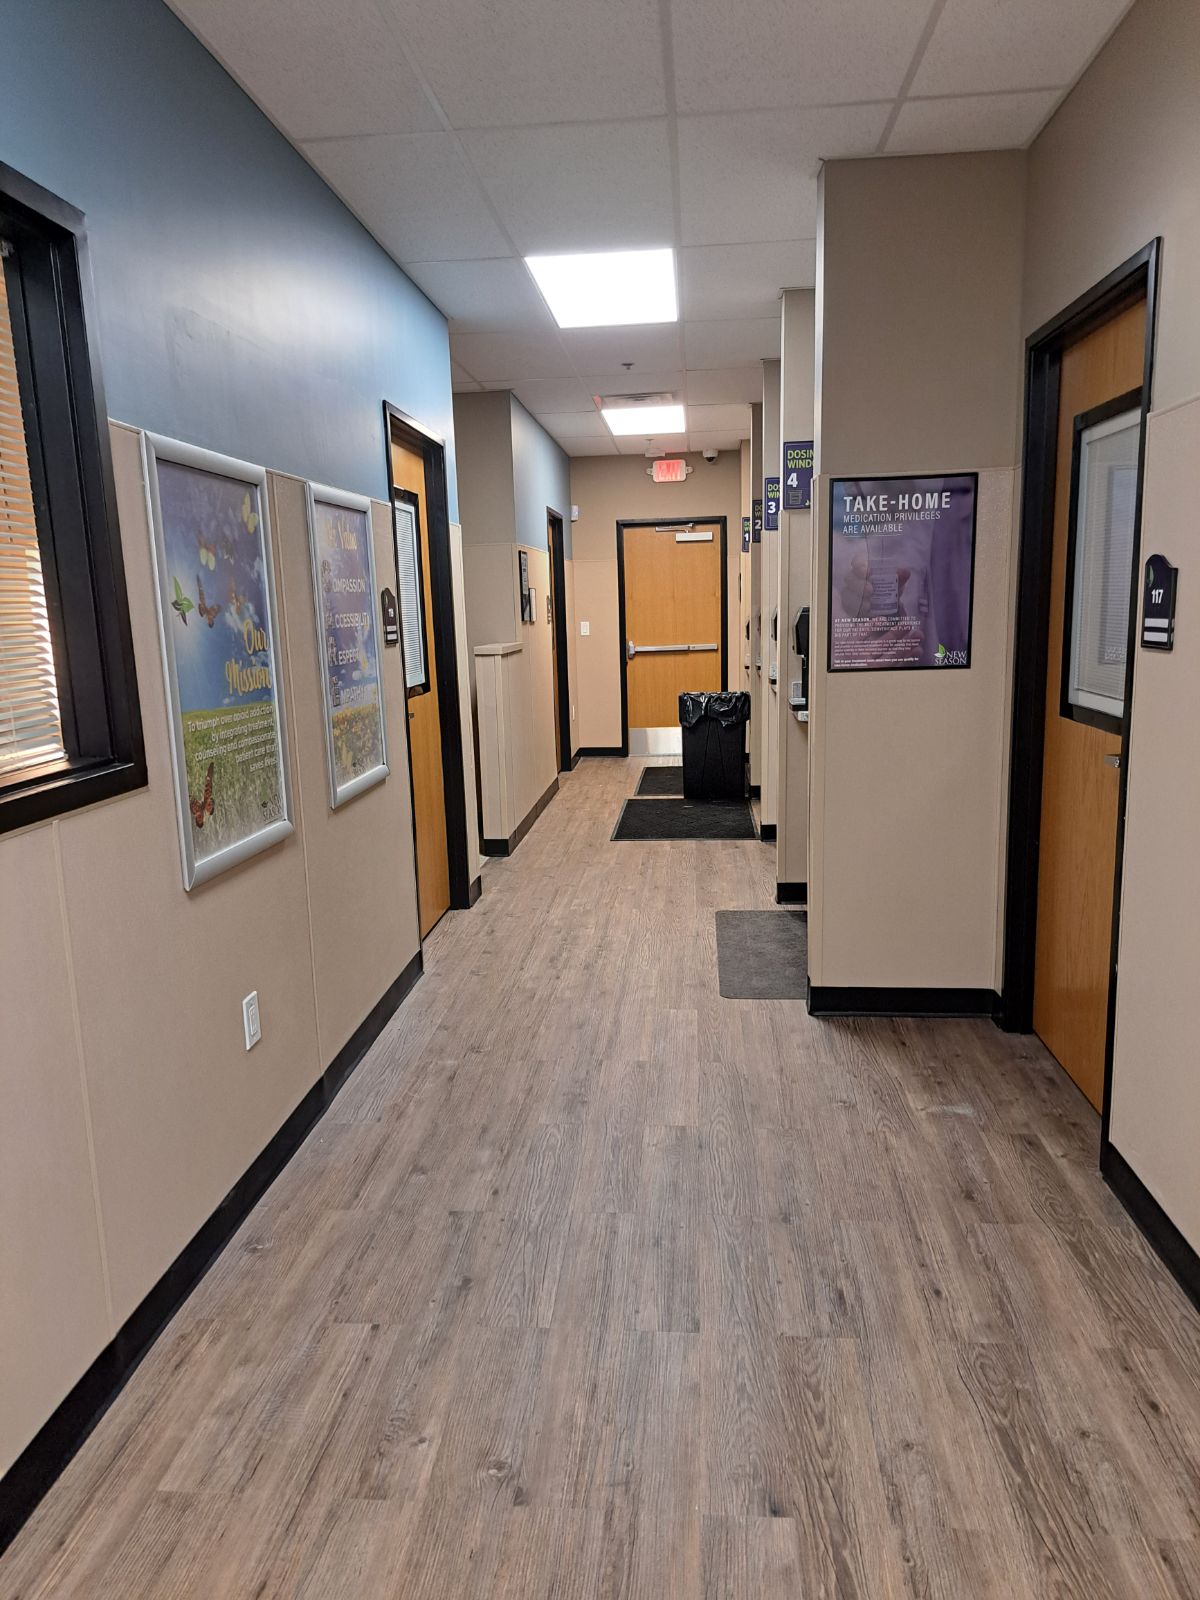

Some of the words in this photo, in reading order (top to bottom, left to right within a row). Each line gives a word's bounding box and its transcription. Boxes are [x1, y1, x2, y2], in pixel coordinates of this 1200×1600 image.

[787, 459, 814, 469] WIND
[787, 472, 798, 488] 4
[768, 502, 776, 513] 3
[843, 492, 951, 512] TAKE-HOME
[755, 519, 762, 530] 2
[843, 513, 892, 523] MEDICATION
[894, 511, 941, 521] PRIVILEGES
[843, 525, 858, 534] ARE
[861, 523, 903, 533] AVAILABLE
[744, 533, 749, 541] 1
[1151, 589, 1164, 604] 117
[242, 618, 269, 654] Our
[946, 650, 967, 658] NEW
[225, 657, 272, 696] Mission
[188, 721, 196, 732] To
[196, 716, 219, 730] triumph
[233, 711, 249, 723] opioid
[250, 705, 274, 718] addiction
[211, 731, 219, 743] by
[220, 725, 248, 740] integrating
[195, 745, 227, 761] counseling
[227, 742, 238, 752] and
[238, 731, 277, 748] compassionate
[236, 750, 254, 764] patient
[254, 746, 266, 757] care
[250, 760, 264, 772] saves
